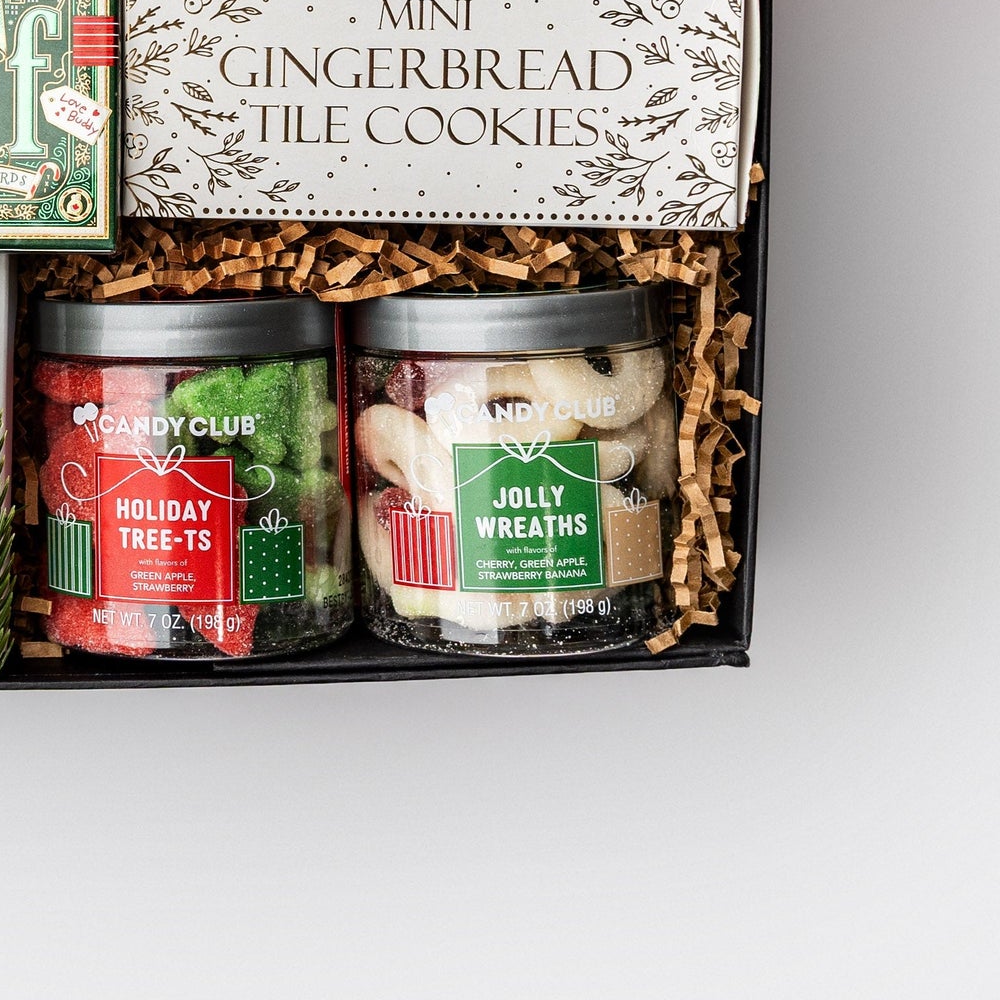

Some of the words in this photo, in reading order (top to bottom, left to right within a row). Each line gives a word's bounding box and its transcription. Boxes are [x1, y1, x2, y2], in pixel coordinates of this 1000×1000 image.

[218, 45, 634, 92] GINGERBREAD
[60, 93, 87, 114] Love
[67, 110, 98, 136] Buddy
[248, 103, 350, 144] TILE
[364, 104, 601, 148] COOKIES
[455, 400, 545, 424] CANDY
[553, 398, 616, 421] CLUB
[99, 415, 187, 437] CANDY
[189, 415, 256, 436] CLUB
[492, 485, 565, 510] JOLLY
[116, 498, 212, 522] HOLIDAY
[475, 513, 588, 539] WREATHS
[119, 527, 211, 551] TREE-TS
[506, 547, 522, 555] with
[523, 545, 548, 554] flavors
[550, 545, 557, 553] of
[138, 558, 153, 566] with
[155, 558, 178, 566] flavors
[180, 558, 187, 566] of
[476, 559, 517, 570] CHERRY,
[519, 558, 554, 568] GREEN
[556, 556, 588, 568] APPLE,
[130, 570, 162, 581] GREEN
[165, 571, 196, 583] APPLE,
[478, 570, 543, 580] STRAWBERRY
[545, 569, 587, 579] BANANA
[132, 582, 194, 593] STRAWBERRY
[519, 603, 527, 616] 7
[534, 601, 557, 617] OZ.
[563, 599, 594, 619] (198
[598, 596, 611, 616] g)
[93, 608, 115, 624] NET
[120, 611, 144, 627] WT.
[149, 614, 155, 628] 7
[161, 614, 185, 629] OZ.
[190, 612, 223, 633] (198
[227, 613, 241, 633] g)
